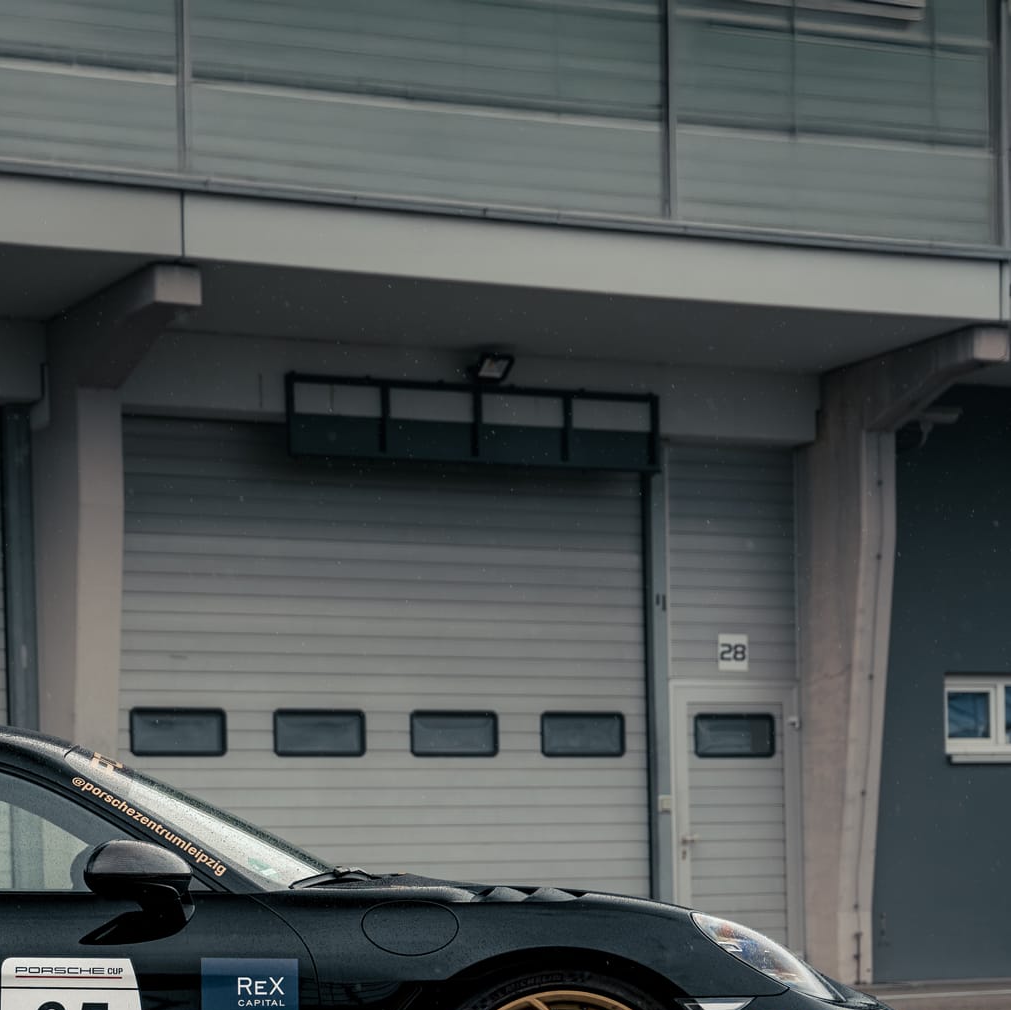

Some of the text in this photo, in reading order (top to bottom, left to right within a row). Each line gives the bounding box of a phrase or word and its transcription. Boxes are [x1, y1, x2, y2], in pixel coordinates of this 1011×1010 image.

[720, 643, 746, 662] 28
[72, 776, 227, 877] @porschezentrumleipzig
[15, 966, 124, 975] PORSCHE CUP
[237, 999, 286, 1007] CAPITAL
